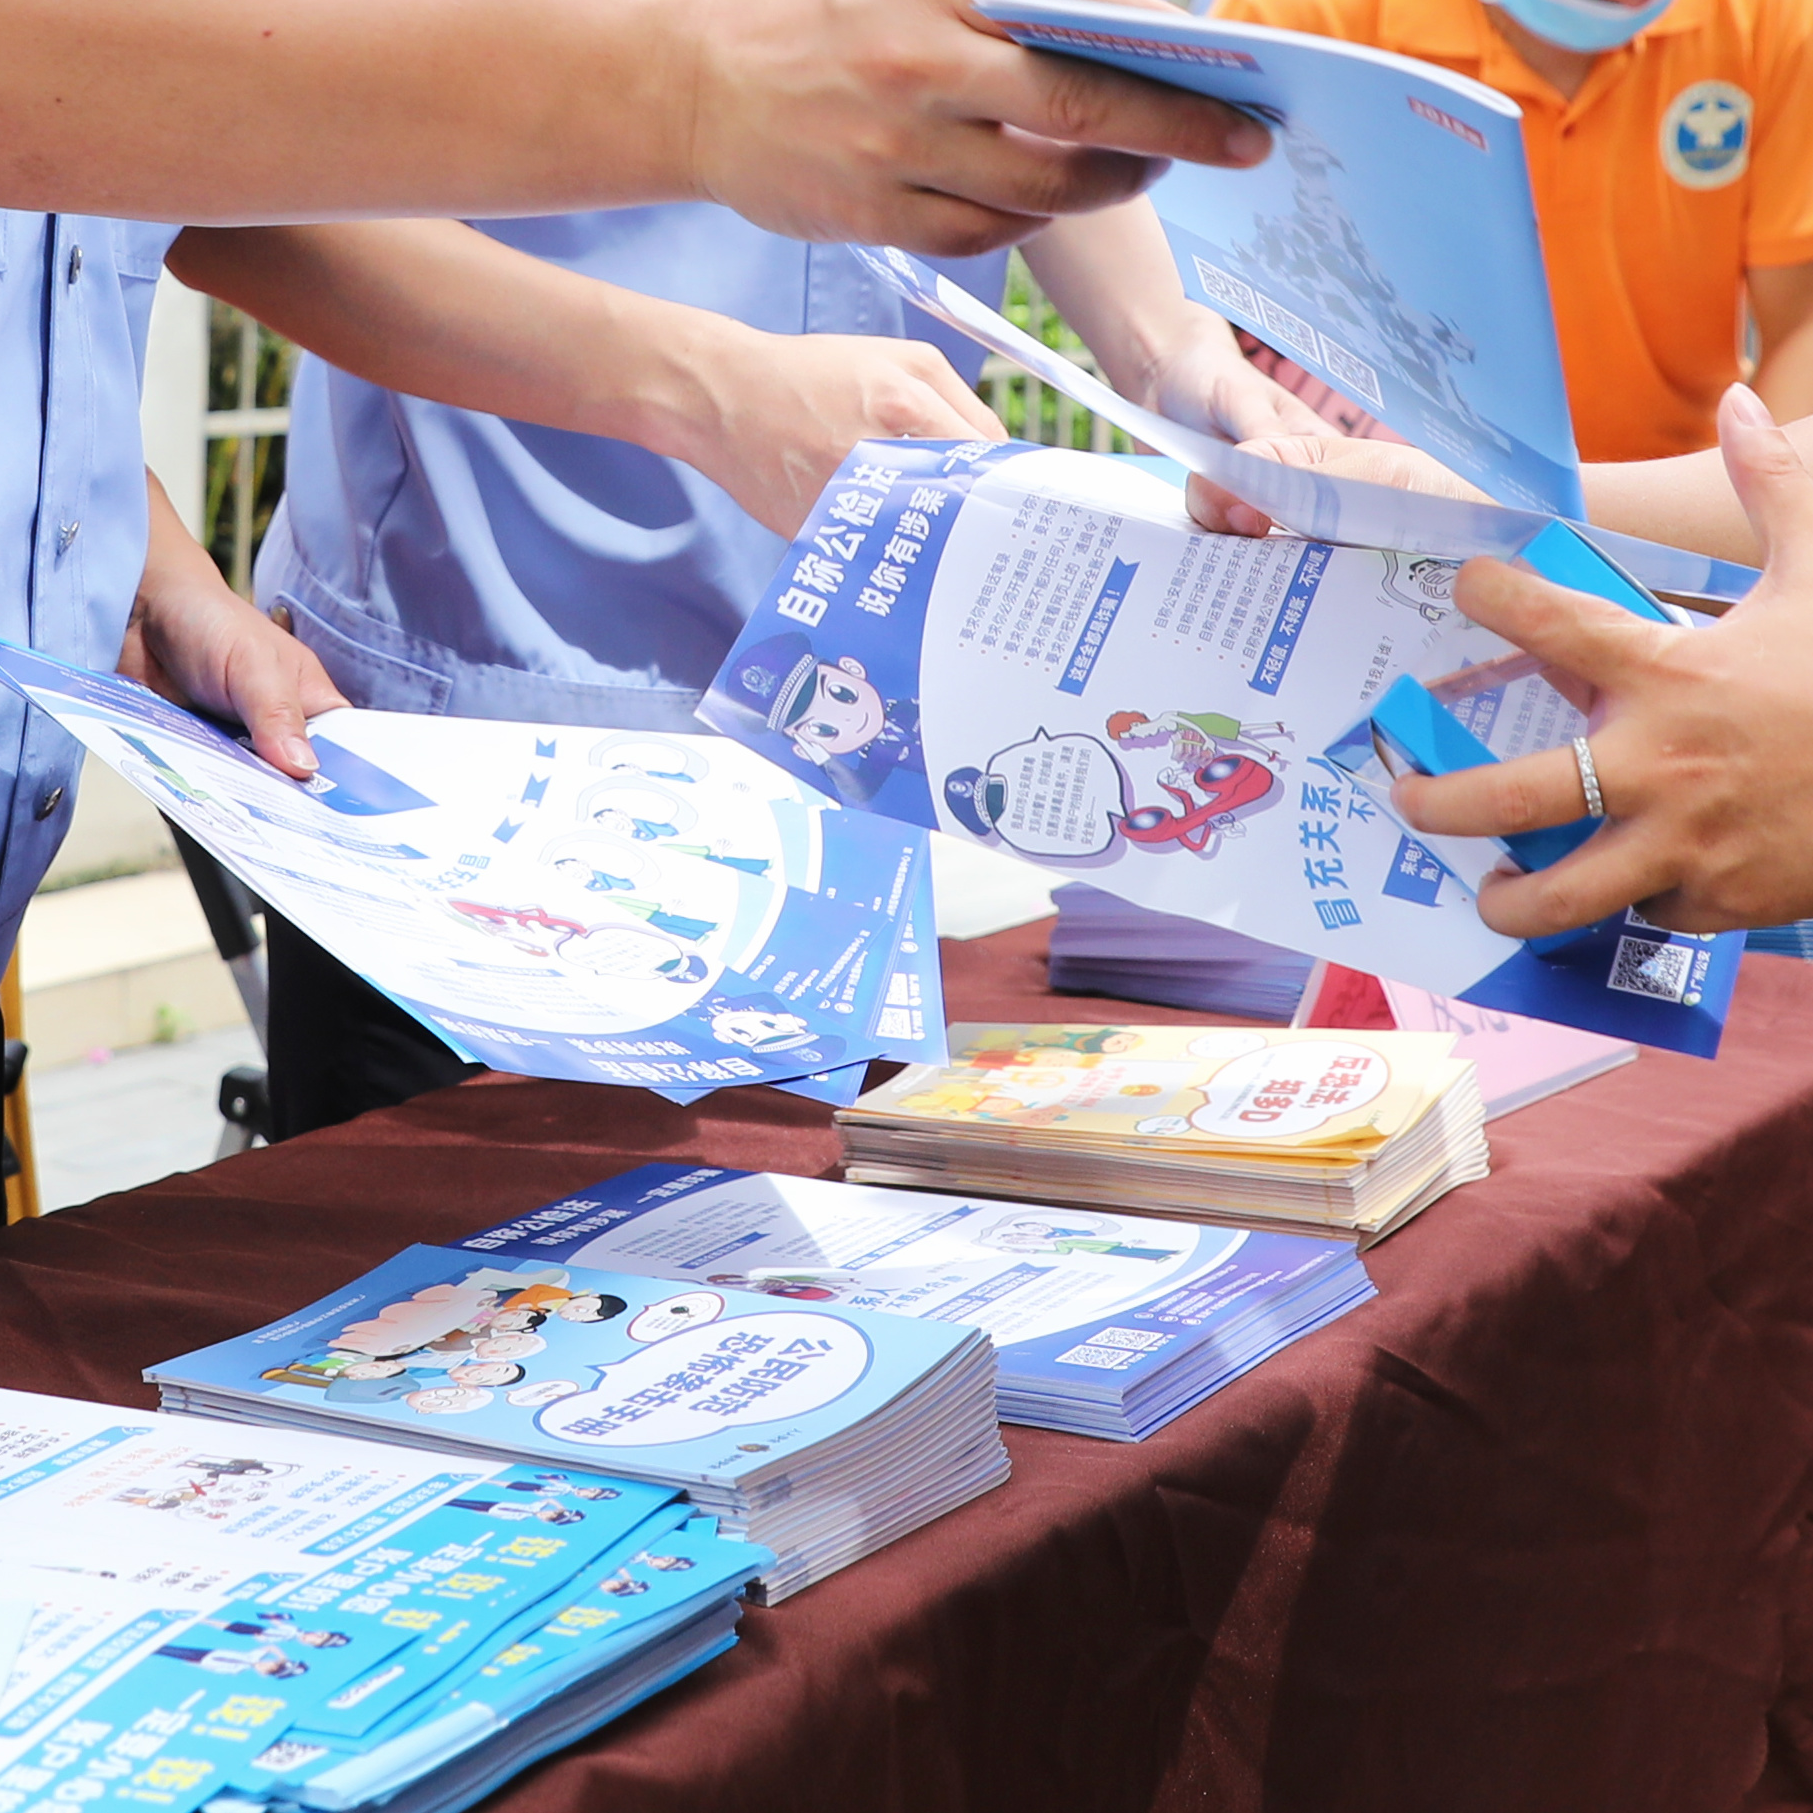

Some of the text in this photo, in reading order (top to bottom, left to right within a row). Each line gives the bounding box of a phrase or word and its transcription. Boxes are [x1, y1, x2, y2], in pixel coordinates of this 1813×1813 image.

[773, 456, 902, 627] 自称公检法
[854, 482, 950, 617] 说你有涉案
[1153, 528, 1206, 629] 自称公安局说你涉嫌
[1689, 950, 1710, 990] 广州公安
[587, 1056, 762, 1079] 自称公检法
[472, 1197, 604, 1250] 自称公检法
[536, 1208, 634, 1245] 说你有涉案
[830, 1285, 902, 1310] 系人
[563, 1328, 779, 1440] 恐怖袭击手册
[702, 1337, 834, 1416] 公民防范
[331, 1532, 482, 1615] 一定要小心您
